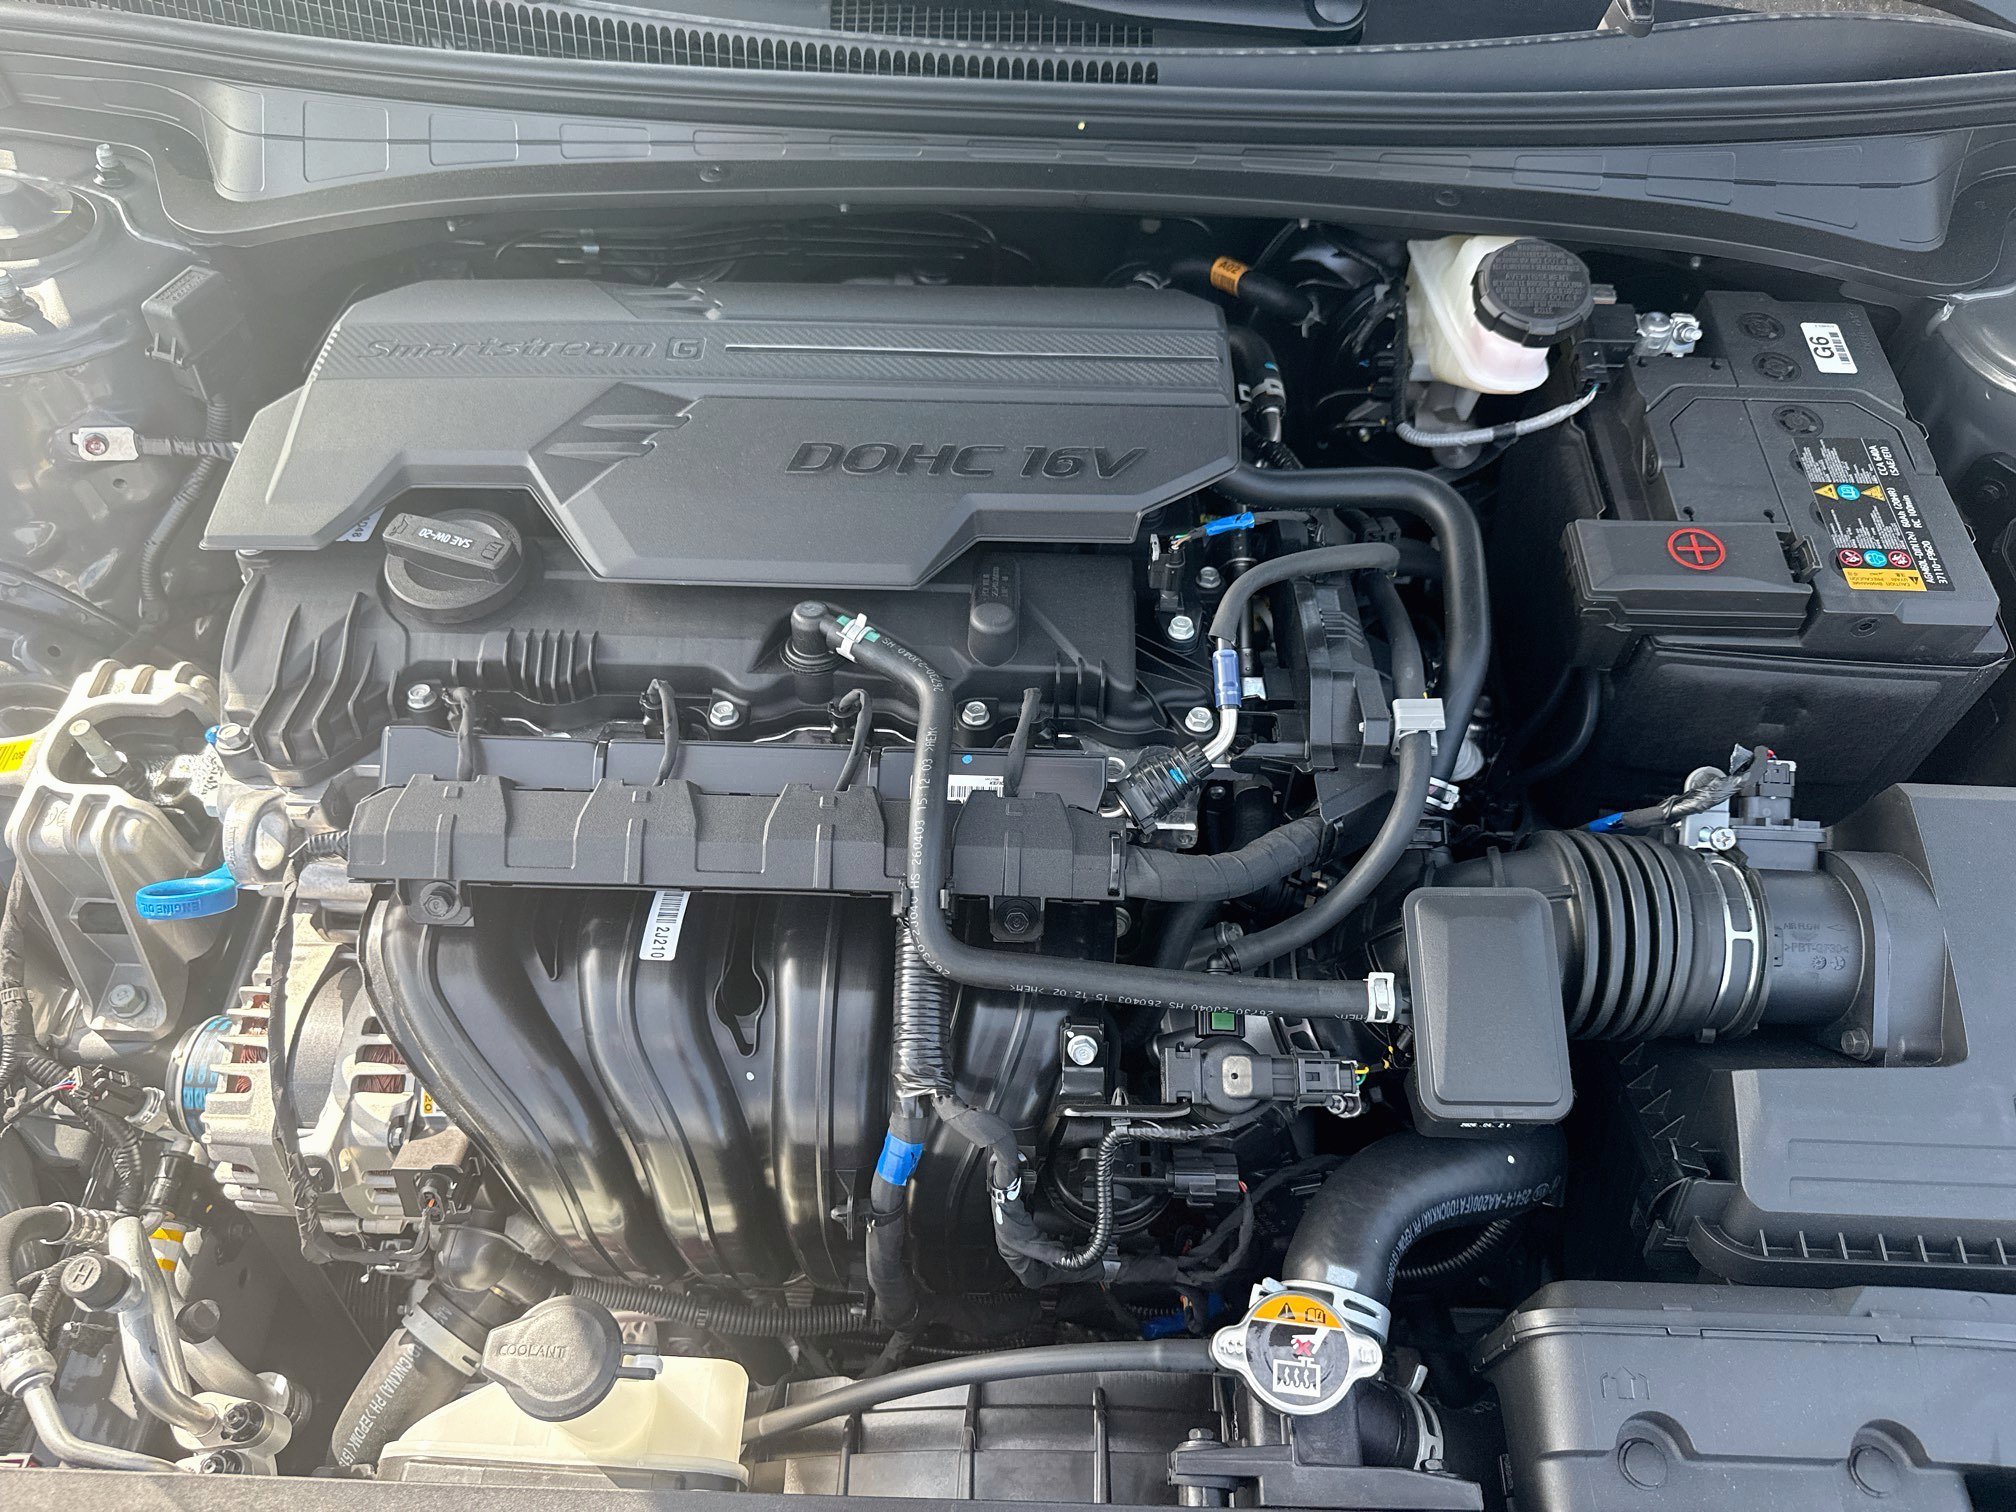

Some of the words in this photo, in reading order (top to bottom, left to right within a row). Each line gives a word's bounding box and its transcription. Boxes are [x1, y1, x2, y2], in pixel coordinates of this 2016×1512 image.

[359, 337, 656, 358] Smartstream
[1809, 337, 1834, 358] G6
[785, 441, 1004, 477] DOHC
[1019, 445, 1148, 479] 16V
[1876, 462, 1888, 475] CCA
[1911, 518, 1922, 528] RC
[418, 528, 452, 543] 0W-20
[452, 537, 473, 558] SAE
[882, 637, 896, 648] HS
[911, 820, 925, 865] 260403
[910, 873, 920, 889] HS
[156, 901, 200, 914] ENGINE
[651, 926, 670, 958] 2J210
[1118, 995, 1162, 1007] 260403
[73, 1264, 94, 1285] H
[499, 1344, 567, 1358] COOLANT
[368, 1395, 388, 1413] PH
